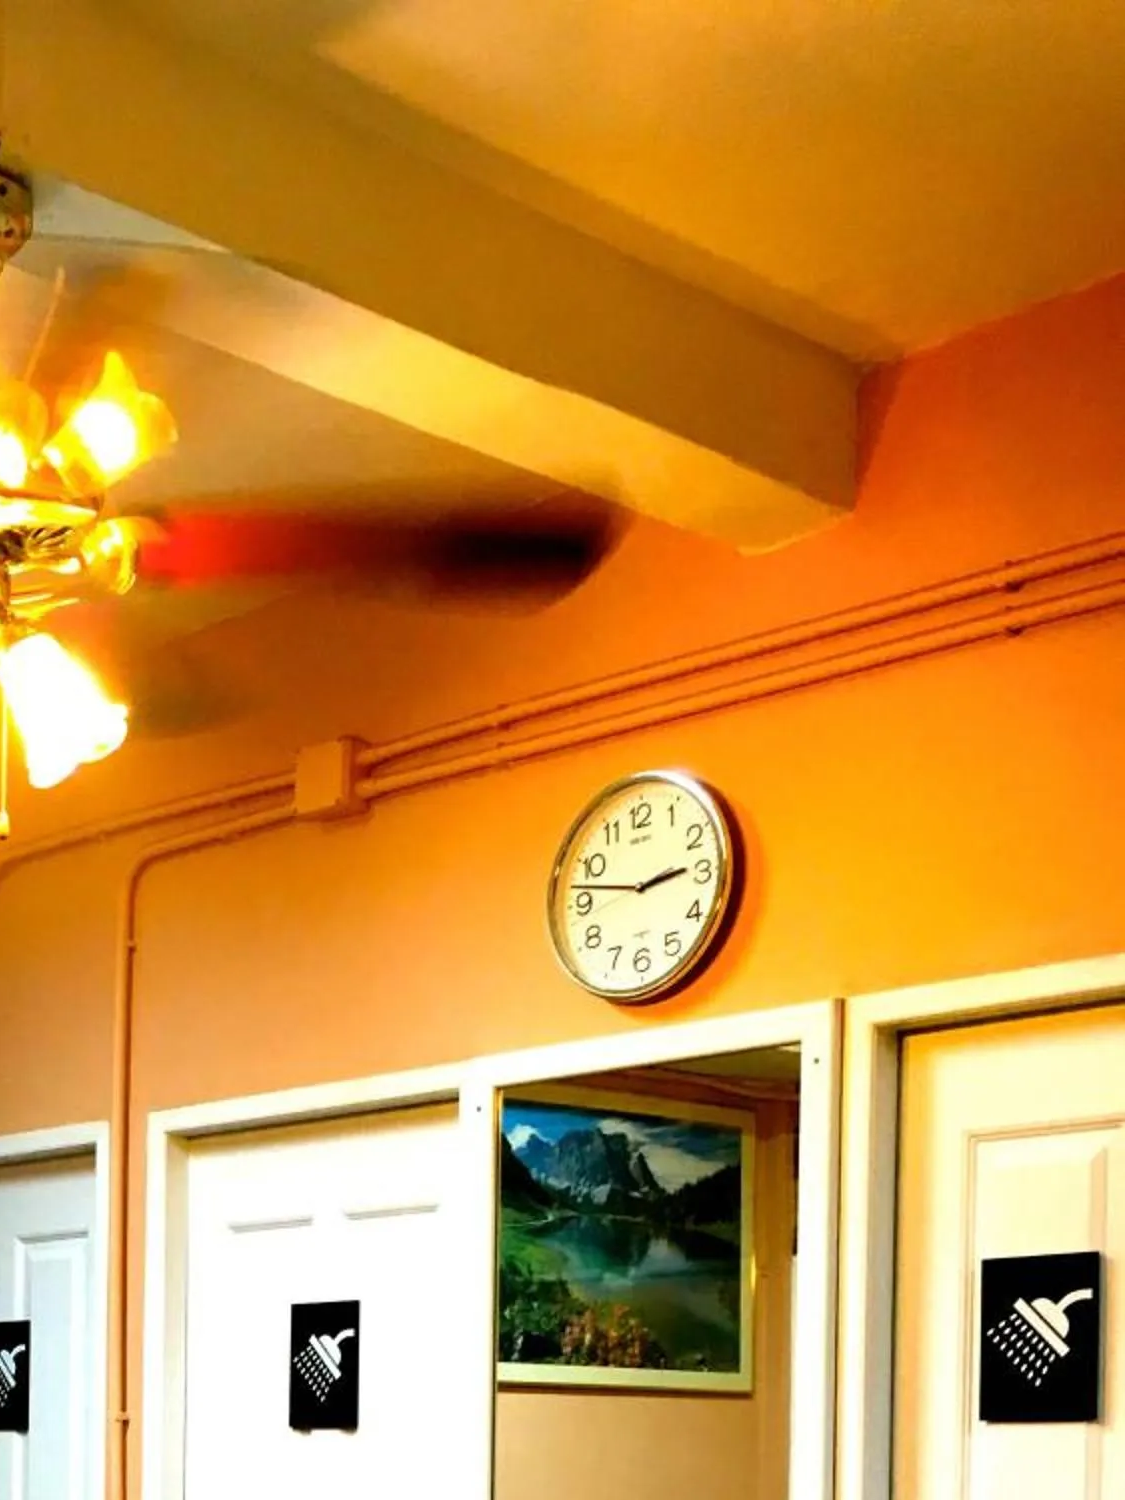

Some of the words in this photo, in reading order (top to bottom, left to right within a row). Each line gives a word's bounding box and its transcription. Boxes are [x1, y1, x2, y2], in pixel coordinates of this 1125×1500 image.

[629, 803, 652, 830] 12
[667, 804, 675, 827] 1
[603, 820, 620, 846] 11
[686, 824, 704, 850] 2
[583, 853, 606, 879] 10
[693, 859, 712, 884] 3
[576, 891, 593, 916] 9
[685, 899, 703, 922] 4
[585, 925, 602, 949] 8
[664, 932, 681, 957] 5
[608, 946, 622, 970] 7
[633, 948, 651, 973] 6
